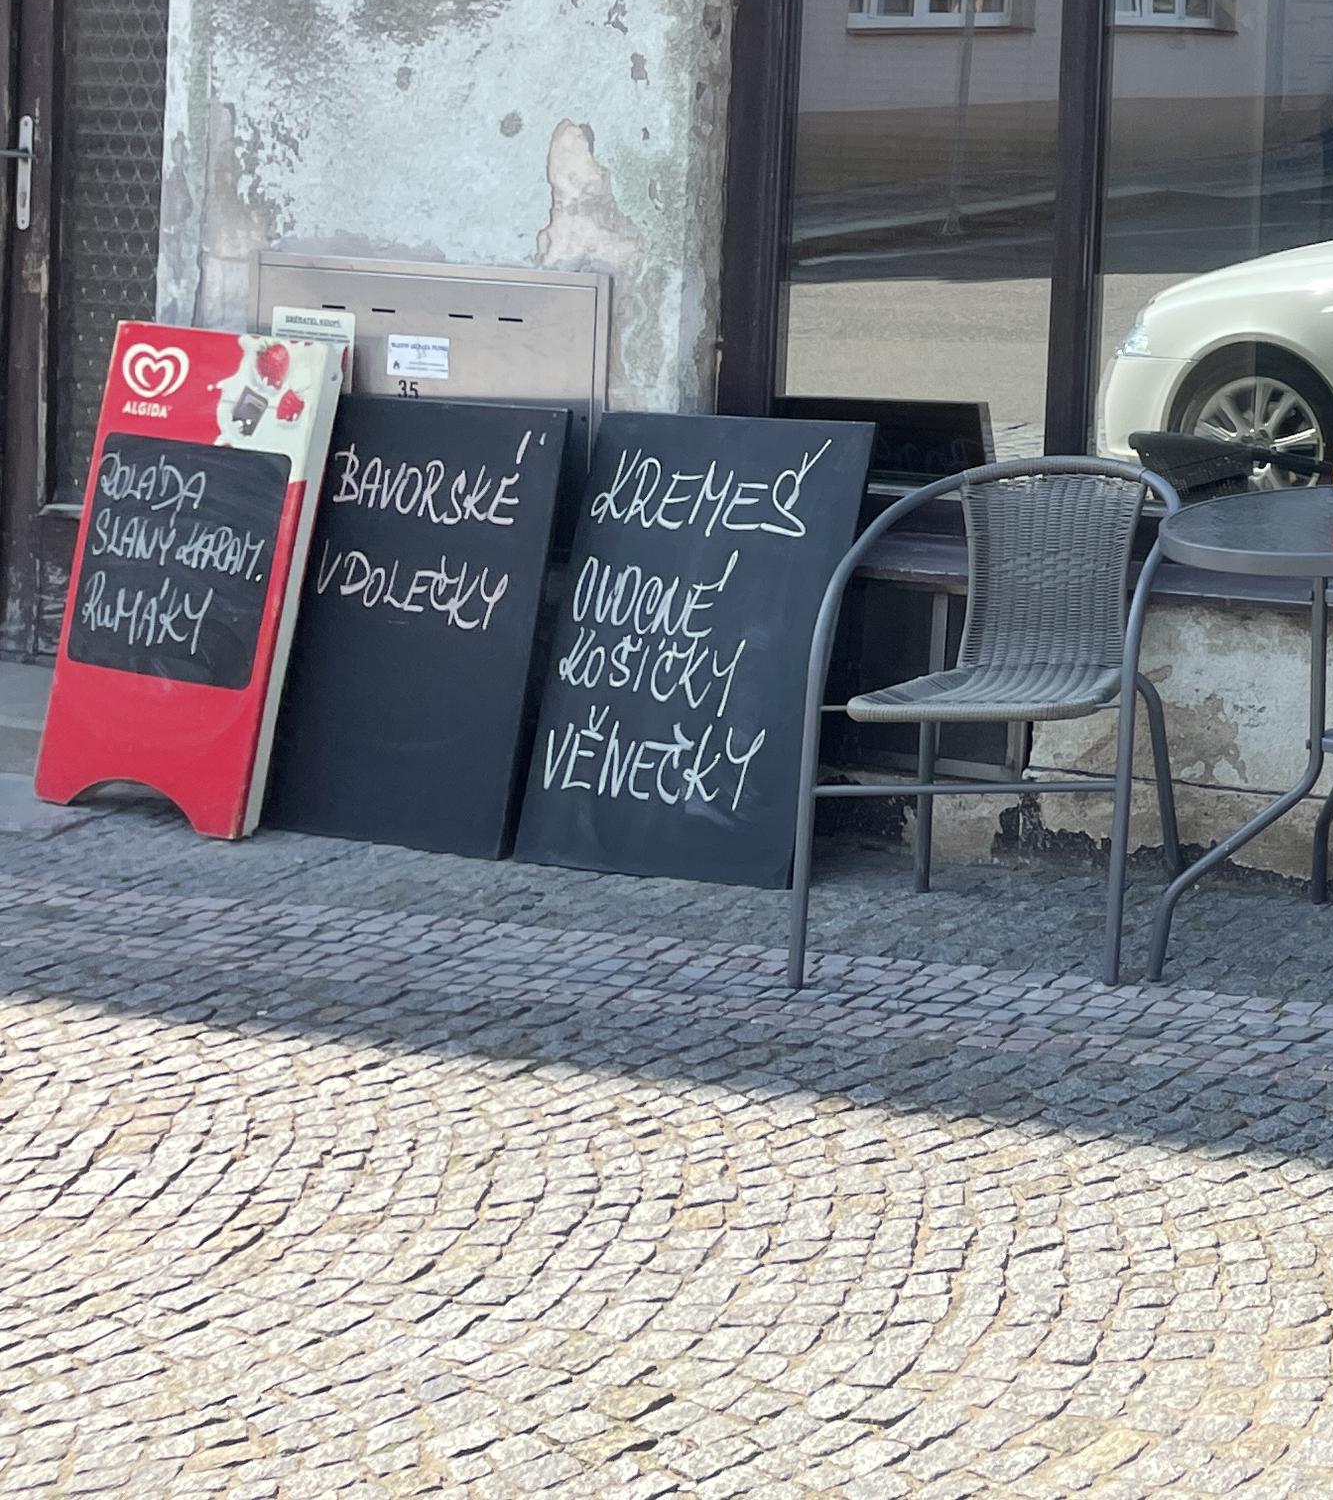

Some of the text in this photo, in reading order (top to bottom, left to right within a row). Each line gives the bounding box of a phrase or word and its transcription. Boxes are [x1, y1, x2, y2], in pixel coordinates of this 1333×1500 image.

[121, 400, 168, 419] ALGIDA
[398, 379, 419, 399] 35
[333, 430, 532, 525] BAVORSKÉ
[317, 539, 509, 631] VDOLEČKY
[572, 549, 739, 639] OVOCNÉ
[543, 704, 767, 811] VĚNEČKY
